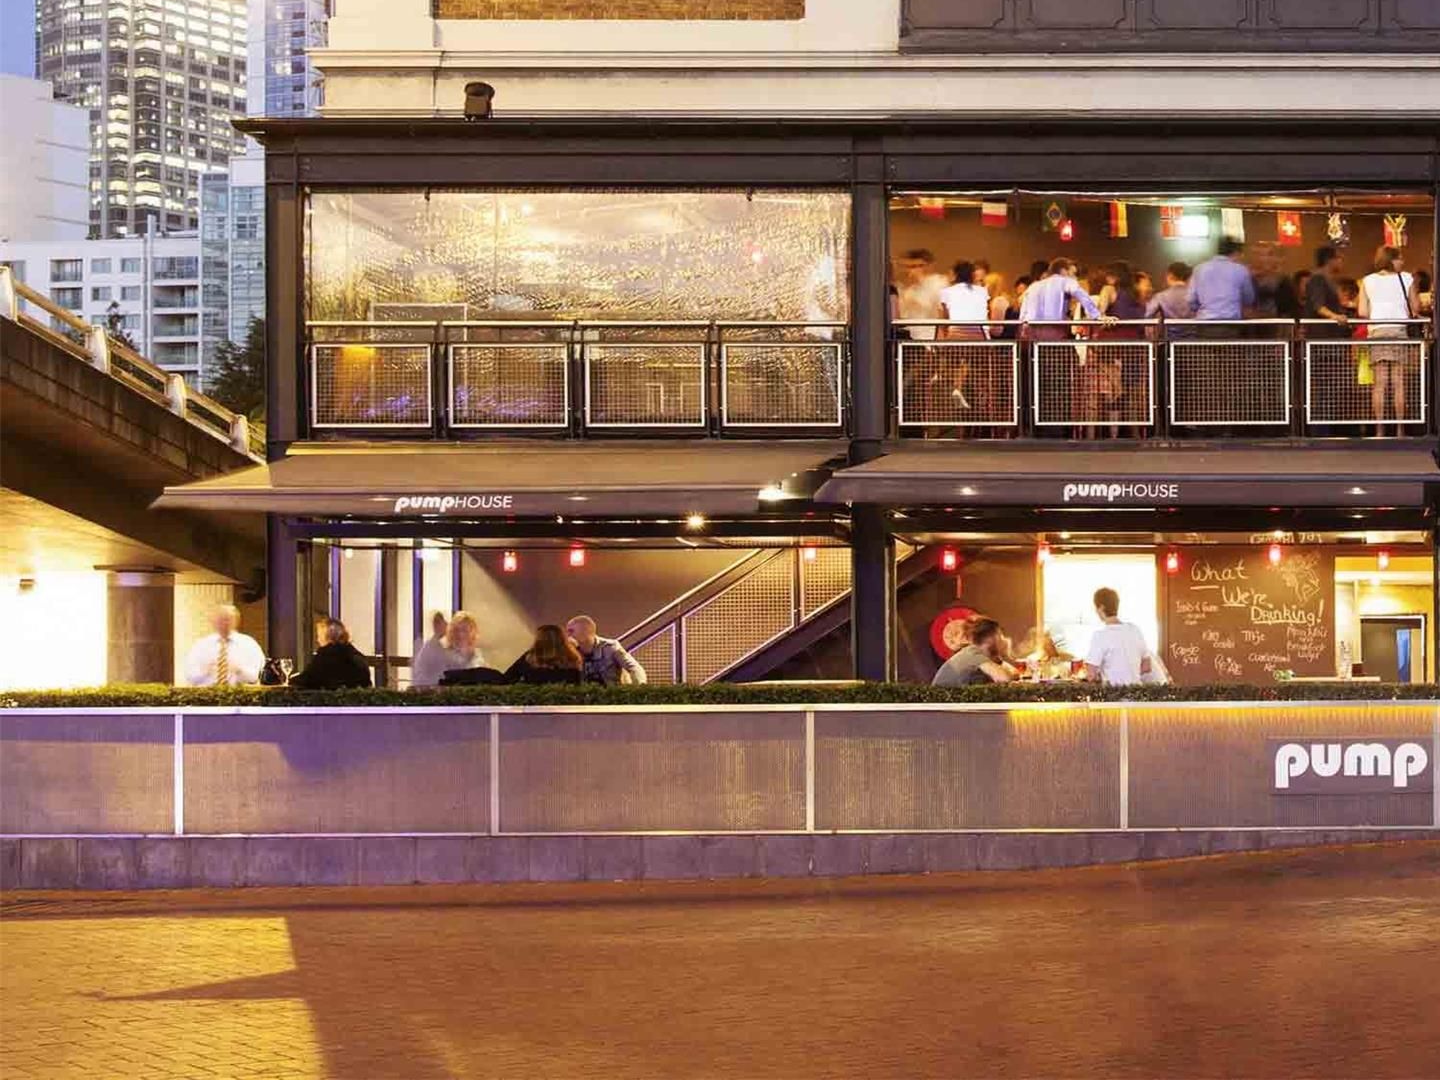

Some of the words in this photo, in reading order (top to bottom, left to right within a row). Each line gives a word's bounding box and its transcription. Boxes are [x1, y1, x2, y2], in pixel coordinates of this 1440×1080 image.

[1063, 483, 1179, 502] pumpHOUSE
[394, 495, 513, 513] pumpHOUSE
[1191, 559, 1249, 582] What
[1222, 585, 1268, 606] We're
[1250, 599, 1325, 626] Drinking!
[1274, 742, 1429, 789] pump
